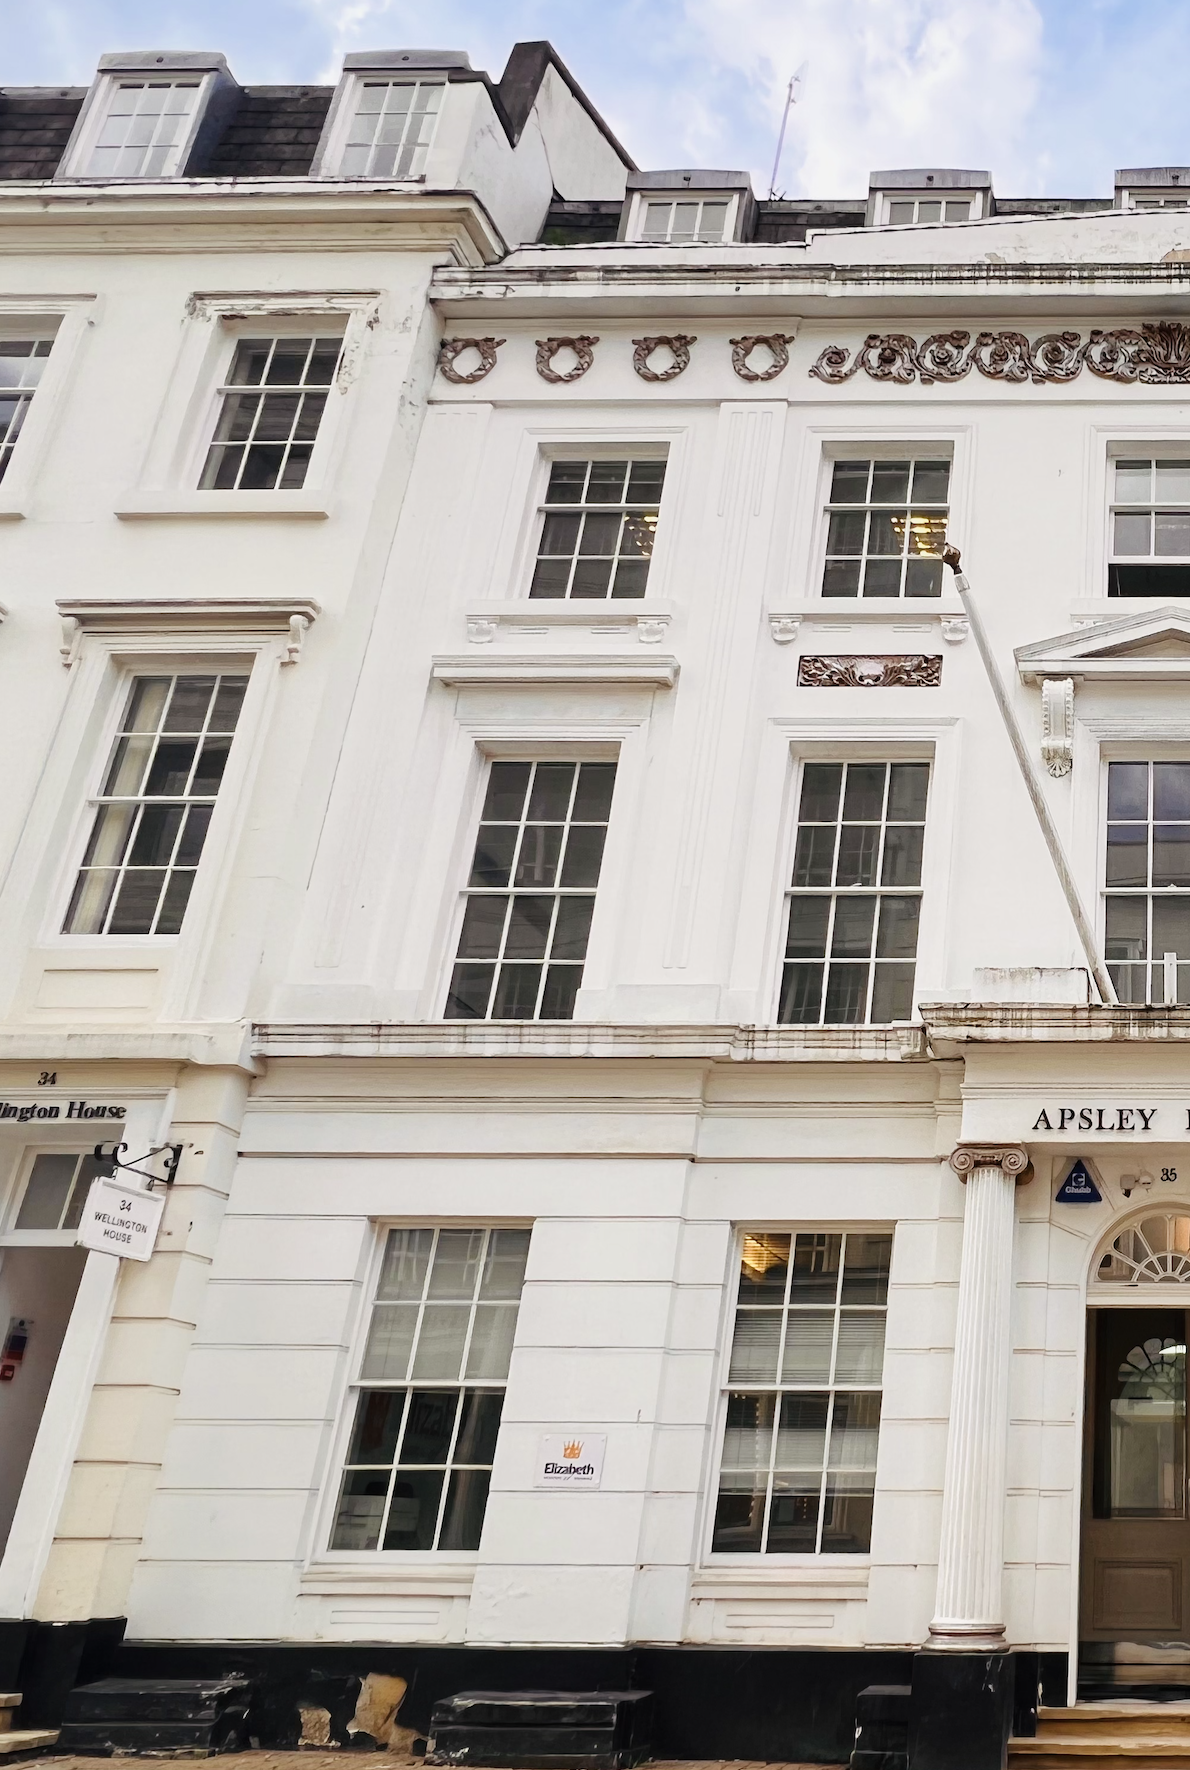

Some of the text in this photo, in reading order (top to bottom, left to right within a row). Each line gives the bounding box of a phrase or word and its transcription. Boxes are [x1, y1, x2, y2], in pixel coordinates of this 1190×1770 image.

[38, 1071, 57, 1085] 34
[65, 1101, 127, 1119] House
[1032, 1108, 1158, 1131] APSLEY
[119, 1199, 132, 1212] 34
[94, 1211, 148, 1234] WELLINGTON
[103, 1228, 132, 1244] HOUSE
[544, 1462, 595, 1475] Elizabeth
